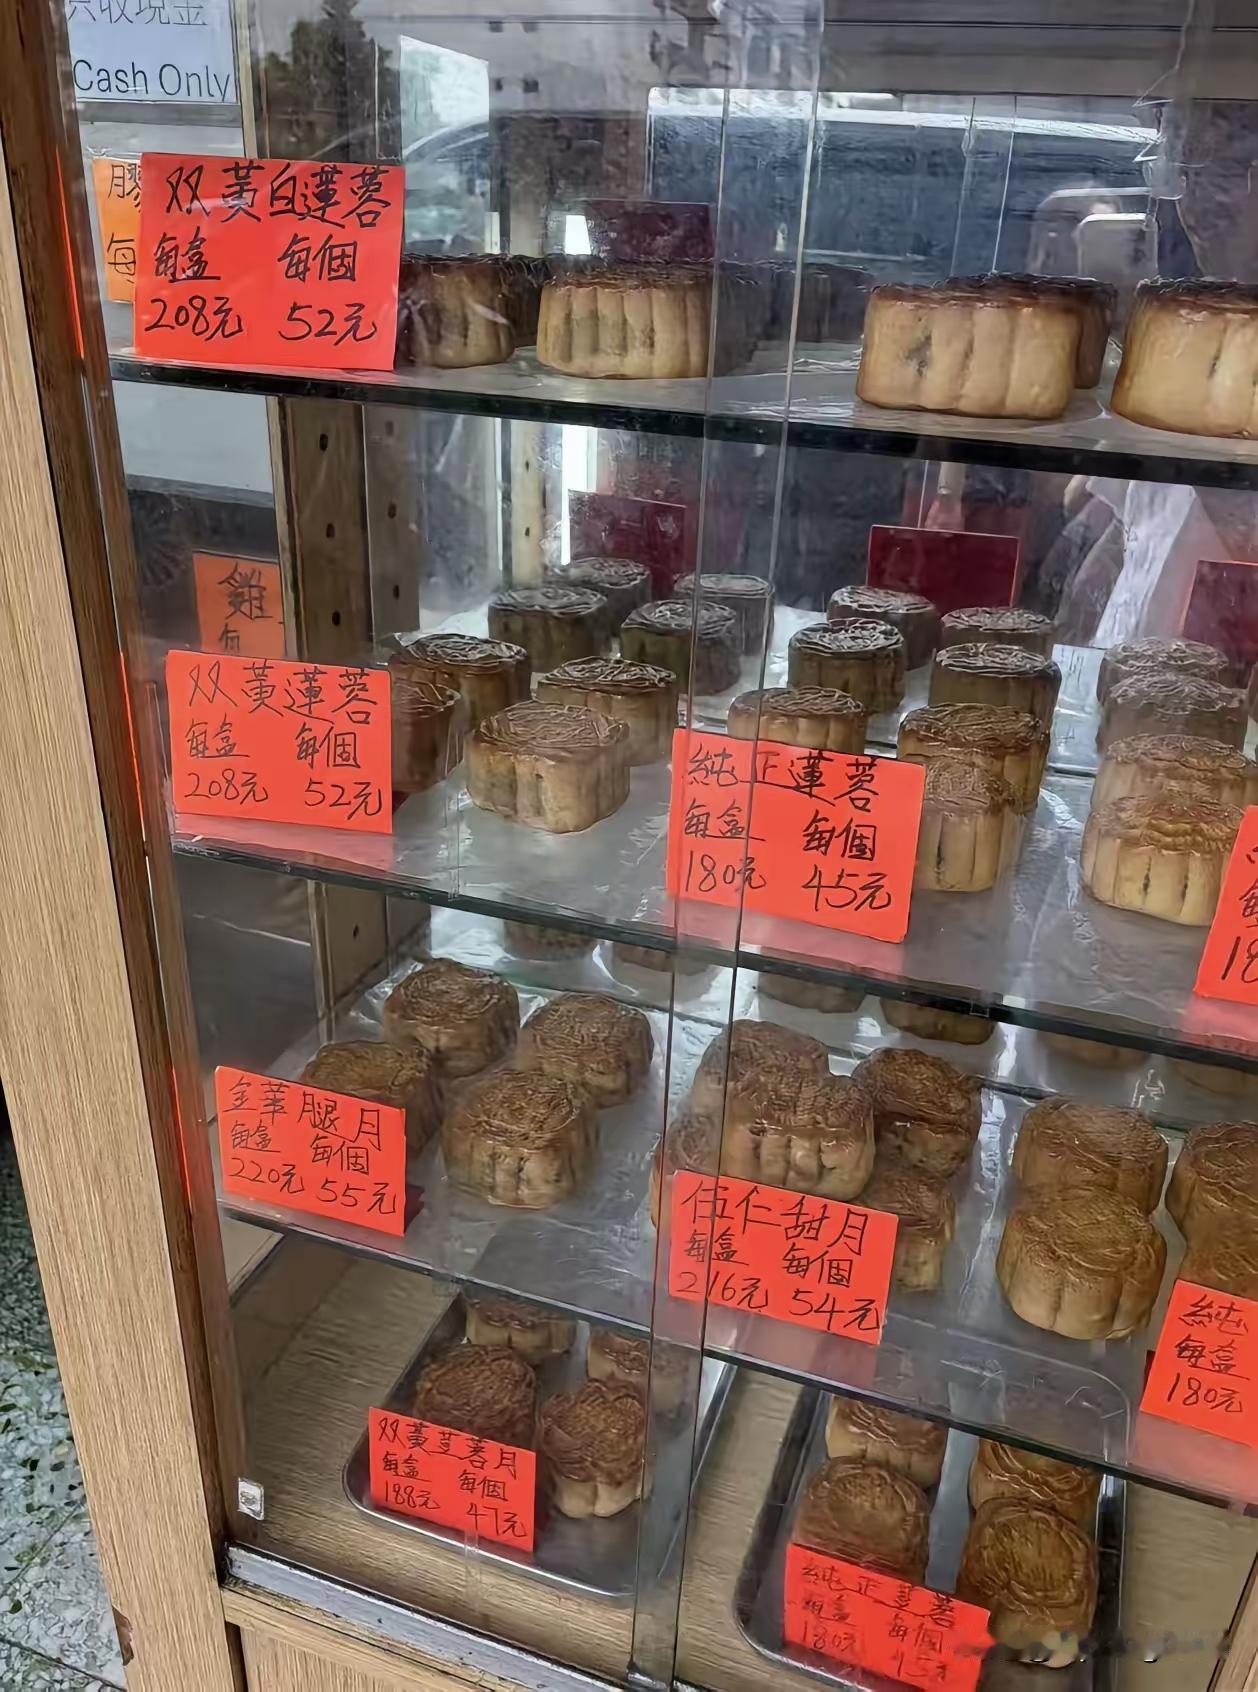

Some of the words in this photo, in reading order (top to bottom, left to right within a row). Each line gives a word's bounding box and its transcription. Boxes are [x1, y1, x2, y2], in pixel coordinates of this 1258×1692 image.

[73, 59, 149, 95] Cash
[158, 63, 231, 102] Only
[152, 227, 222, 284] 每盒
[277, 232, 357, 284] 每個
[144, 295, 245, 342] 208元
[278, 301, 378, 346] 52元
[184, 713, 251, 760] 每盒
[295, 721, 362, 769] 每個
[183, 768, 269, 805] 208元
[304, 778, 383, 821] 52元
[684, 797, 766, 843] 每盒
[801, 808, 877, 862] 每個
[685, 849, 766, 893] 180元
[800, 863, 892, 912] 45元
[230, 1119, 281, 1153] 每盒
[309, 1133, 370, 1176] 每個
[228, 1157, 305, 1194] 220元
[315, 1177, 397, 1215] 55元
[684, 1226, 750, 1267] 每盒
[782, 1241, 854, 1289] 每個
[676, 1270, 770, 1311] 216元
[789, 1288, 881, 1332] 54元
[1174, 1334, 1251, 1382] 每盒
[1167, 1372, 1244, 1413] 180元
[382, 1450, 433, 1483] 每盒
[458, 1468, 509, 1503] 每個
[384, 1481, 441, 1511] 188元
[466, 1503, 528, 1538] 47元
